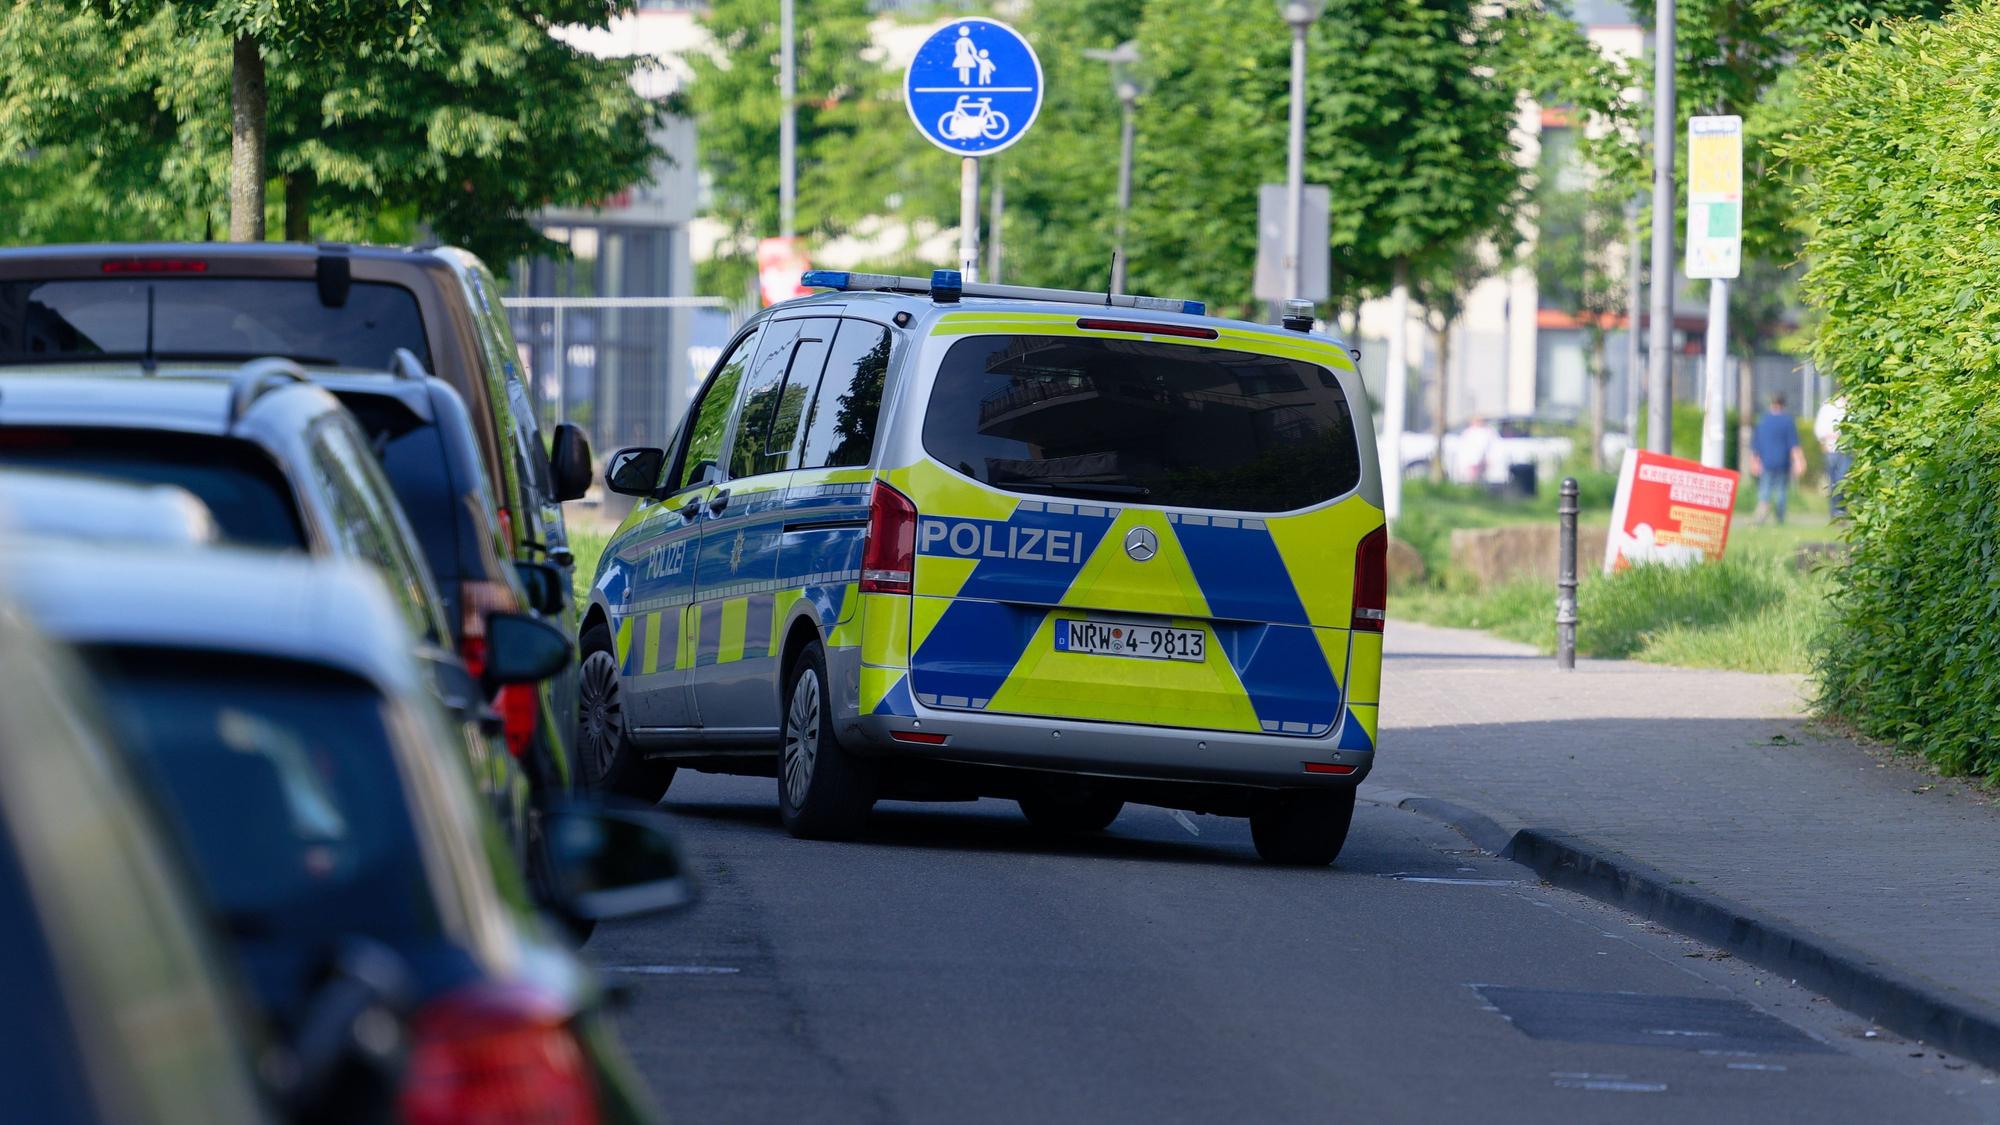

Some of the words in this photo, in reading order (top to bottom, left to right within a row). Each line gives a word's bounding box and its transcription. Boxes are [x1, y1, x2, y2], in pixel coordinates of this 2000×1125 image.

[646, 540, 687, 580] POLIZEI
[922, 520, 1083, 563] POLIZEI
[1071, 623, 1111, 650] NRW
[1126, 629, 1203, 656] 4-9813
